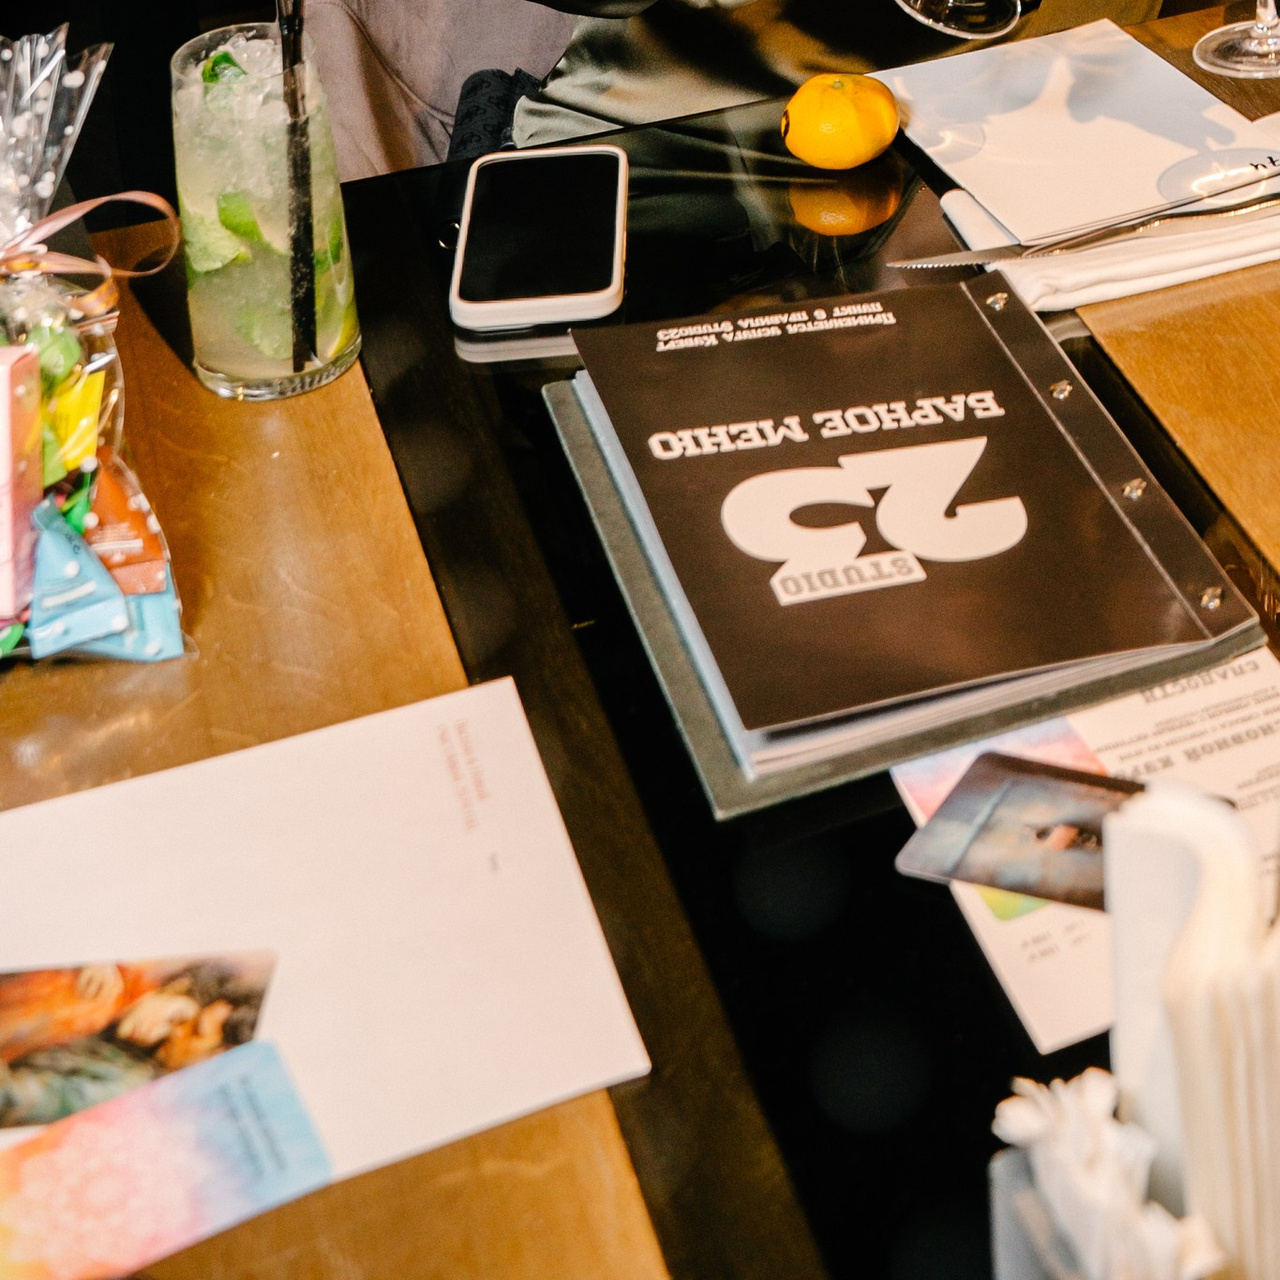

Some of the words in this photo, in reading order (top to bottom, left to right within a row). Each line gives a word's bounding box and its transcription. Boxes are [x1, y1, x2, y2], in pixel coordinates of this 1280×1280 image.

[647, 415, 809, 459] МЕНЮ
[812, 390, 1006, 438] БАРНОЕ
[720, 437, 1028, 562] 23
[780, 558, 915, 596] STUDIO
